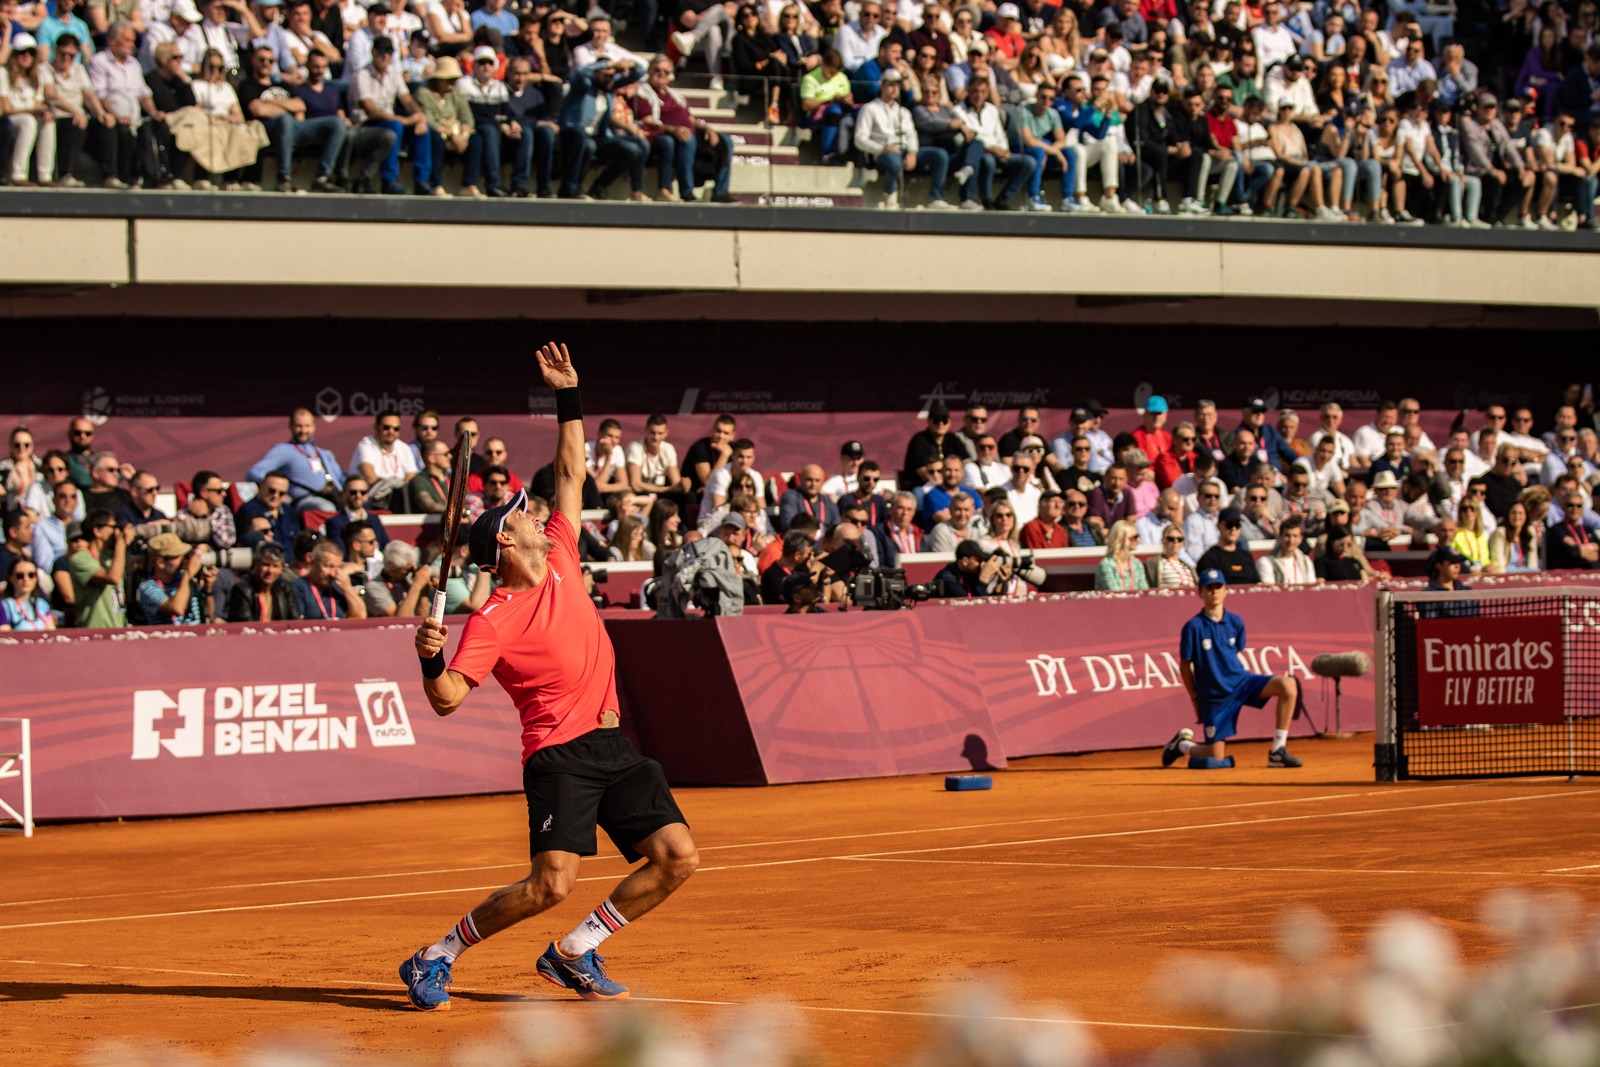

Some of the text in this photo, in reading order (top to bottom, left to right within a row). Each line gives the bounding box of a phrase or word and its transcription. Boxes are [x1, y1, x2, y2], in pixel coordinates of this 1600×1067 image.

[350, 391, 424, 416] Cubes
[1423, 635, 1554, 672] Emirates
[213, 683, 328, 720] DIZEL
[1444, 676, 1535, 705] FLY BETTER
[213, 716, 358, 756] BENZIN
